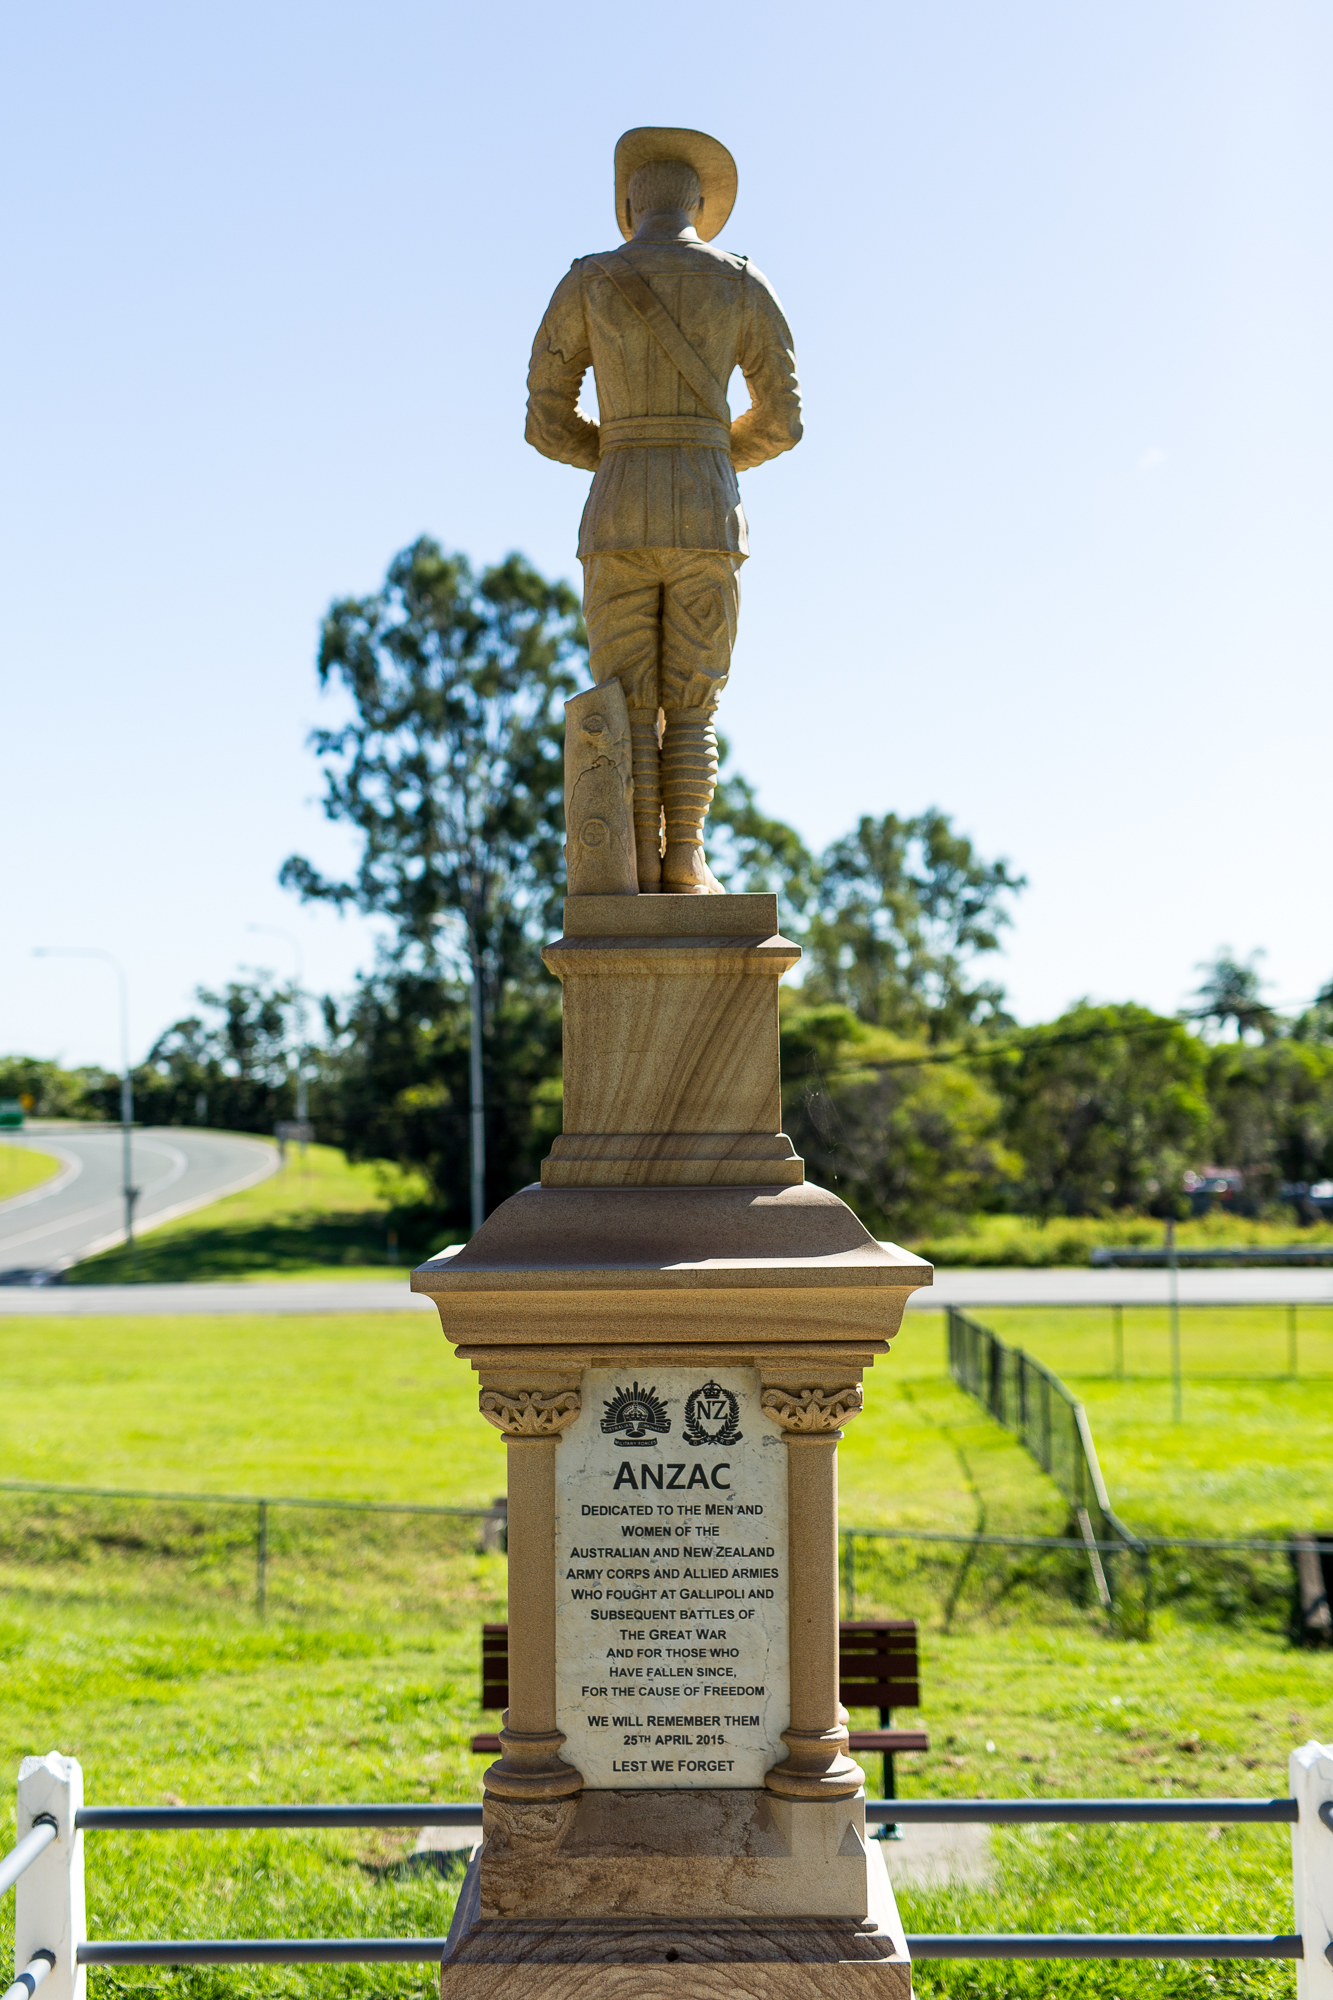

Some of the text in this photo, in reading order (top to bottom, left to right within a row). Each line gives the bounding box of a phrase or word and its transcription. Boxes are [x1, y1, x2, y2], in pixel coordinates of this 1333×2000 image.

[696, 1401, 728, 1419] NZ
[613, 1462, 730, 1490] ANZAC
[582, 1504, 763, 1516] DEDICATED TO THE MEN AND
[622, 1526, 719, 1537] WOMEN OF THE
[570, 1546, 774, 1558] AUSTRALIAN AND NEW ZEALAND
[566, 1568, 779, 1579] ARMY CORPS AND ALLIED ARMIES
[571, 1589, 774, 1600] WHO FOUGHT AT GALLIPOLI AND
[591, 1608, 754, 1620] SUBSEQUENT BATTLES OF
[620, 1629, 726, 1640] THE GREAT WAR
[607, 1648, 739, 1658] AND FOR THOSE WHO
[610, 1667, 736, 1679] HAVE FALLEN SINCE,
[582, 1686, 764, 1697] FOR THE CAUSE OF FREEDOM
[588, 1716, 759, 1727] WE WILL REMEMBER THEM
[655, 1735, 692, 1745] APRIL
[697, 1735, 724, 1745] 2015
[613, 1760, 734, 1772] LEST WE FORGET
